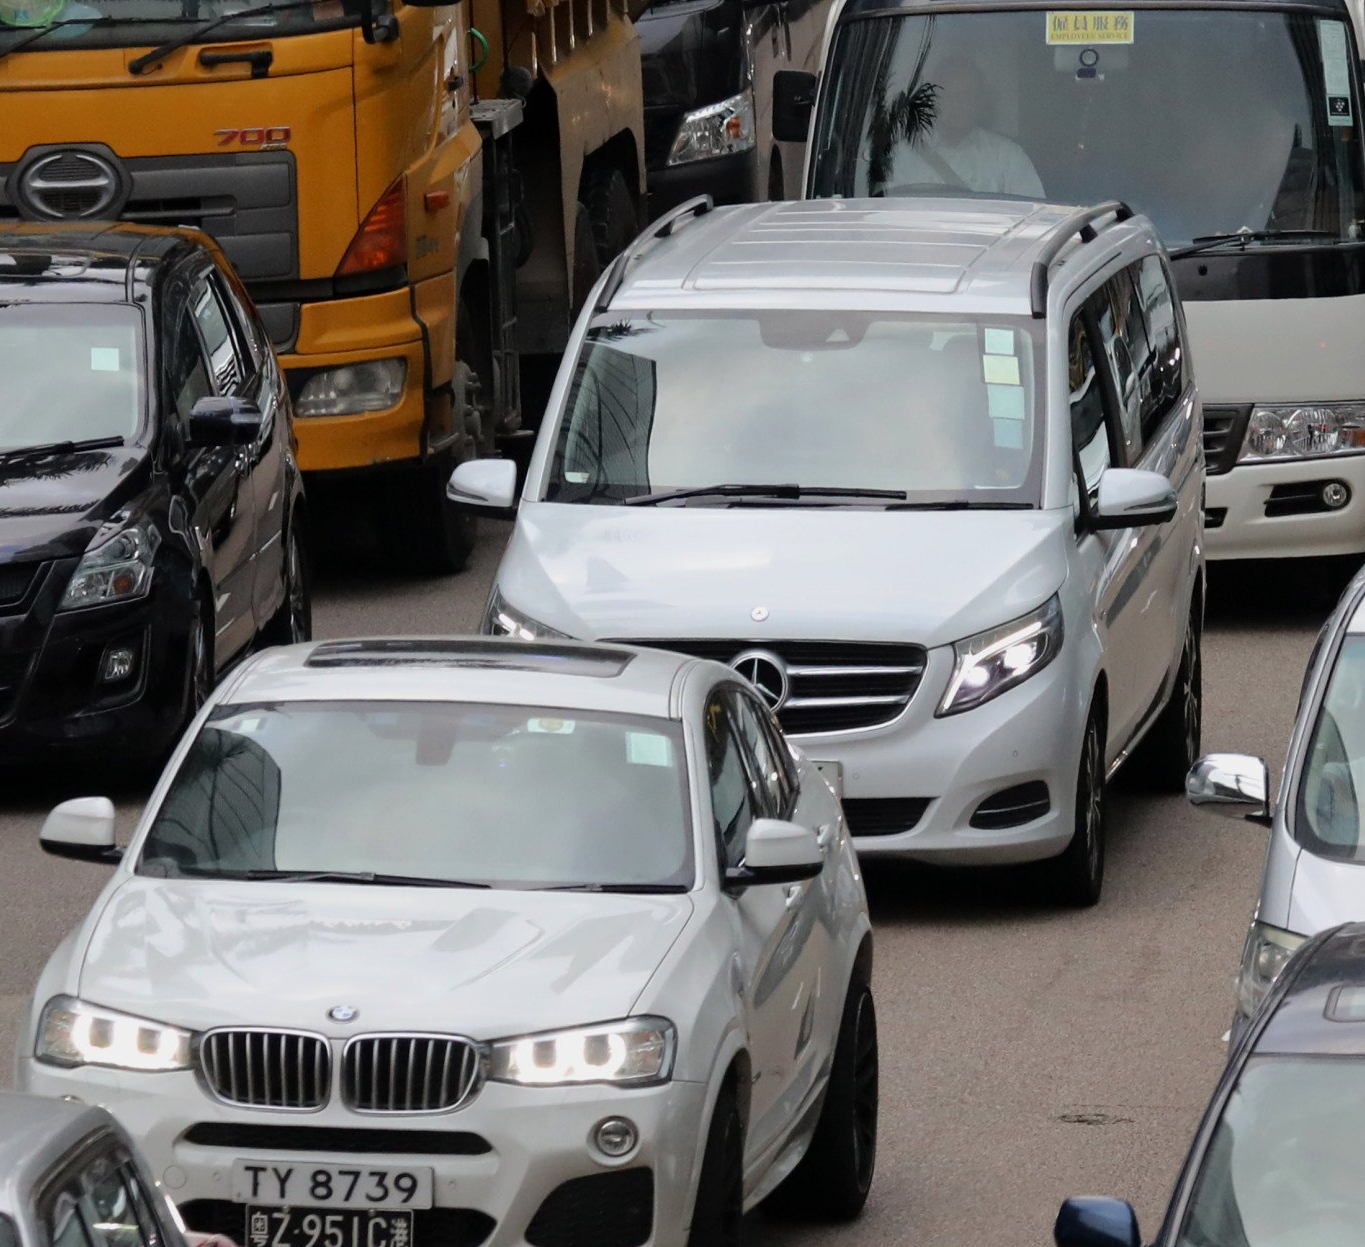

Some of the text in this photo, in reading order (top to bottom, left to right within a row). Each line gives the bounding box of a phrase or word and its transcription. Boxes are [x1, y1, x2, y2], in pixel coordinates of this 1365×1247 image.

[213, 127, 292, 146] 700
[244, 1165, 419, 1203] TY 8739
